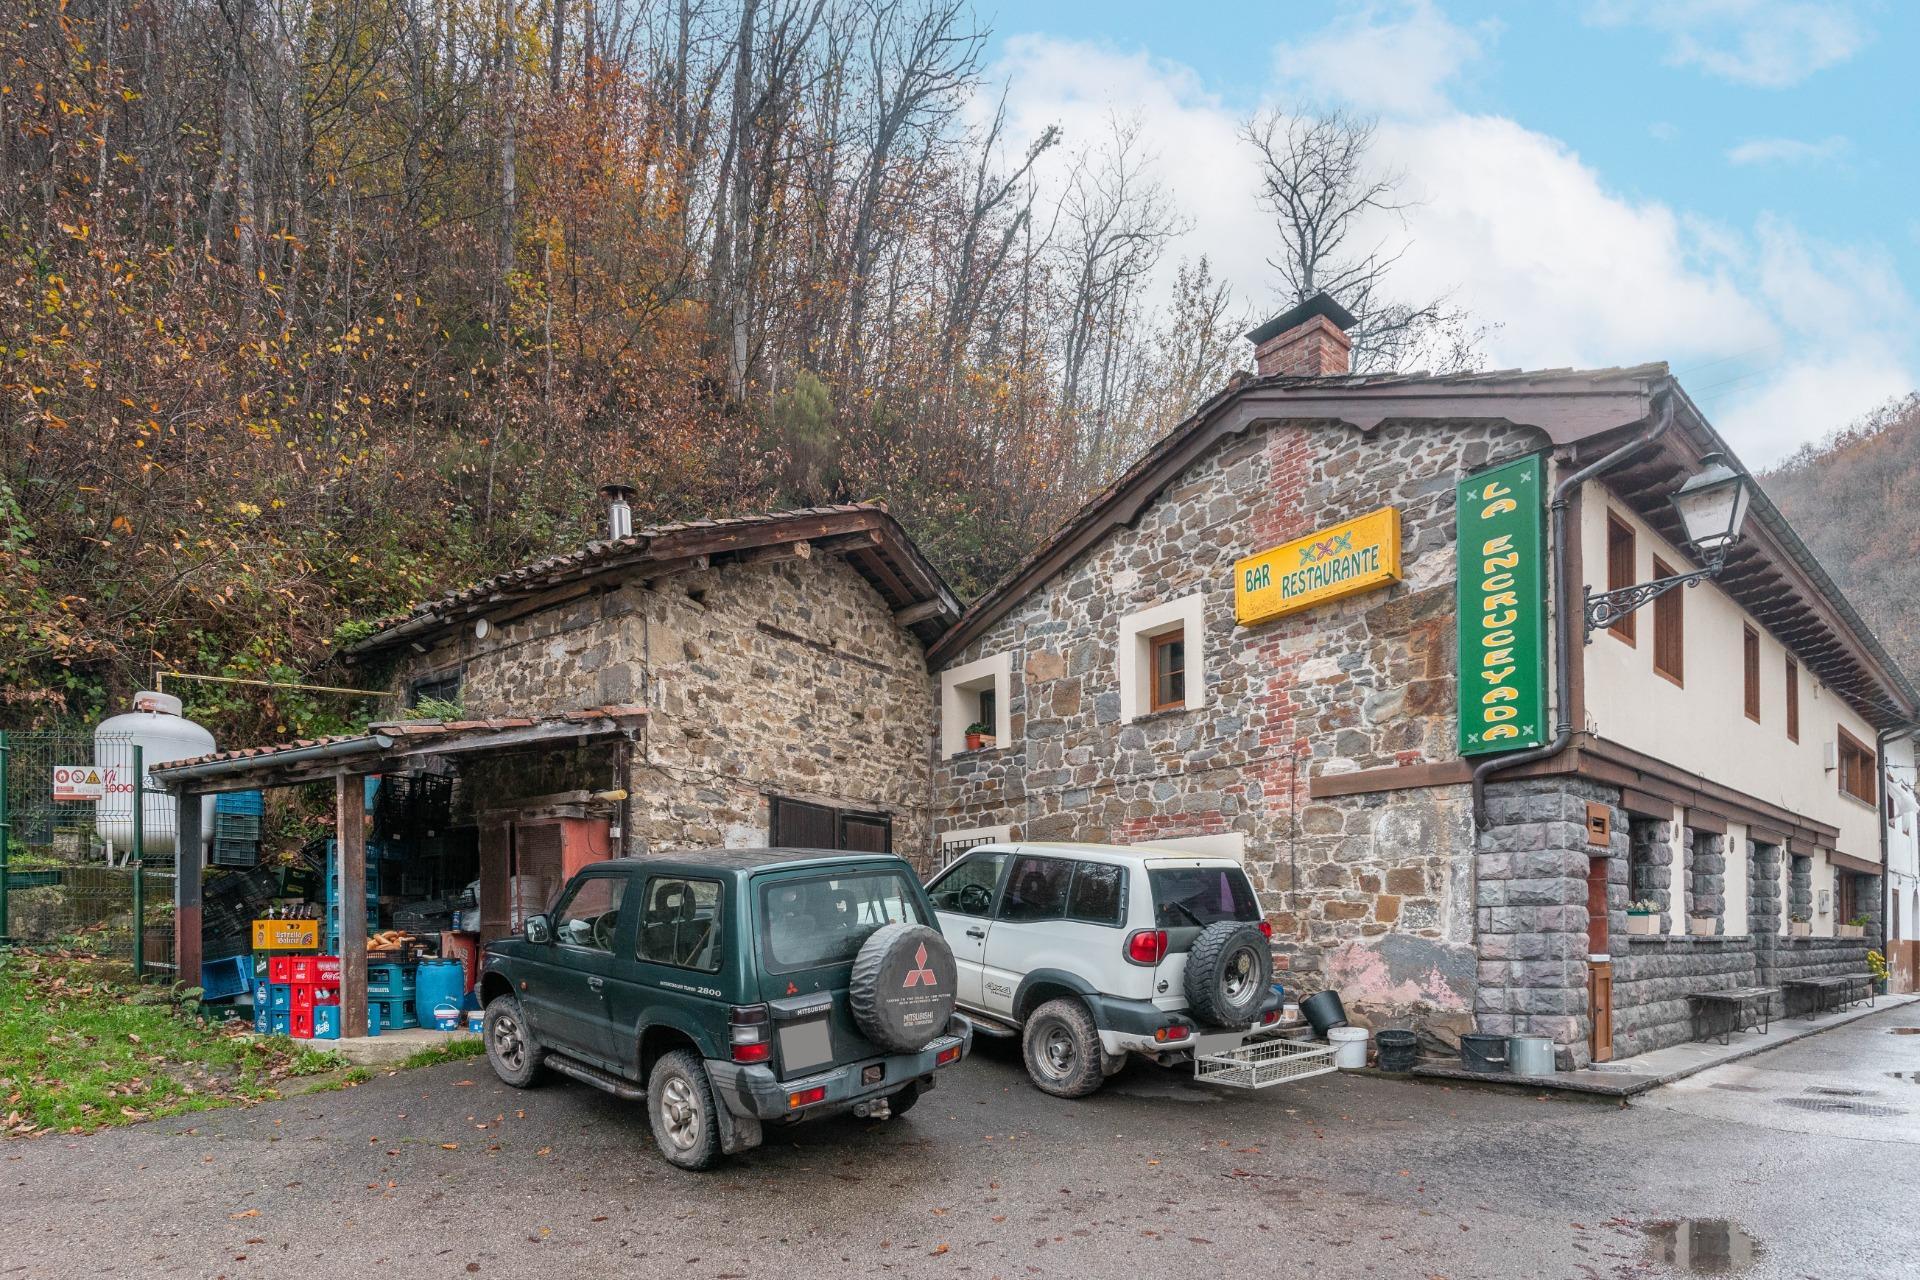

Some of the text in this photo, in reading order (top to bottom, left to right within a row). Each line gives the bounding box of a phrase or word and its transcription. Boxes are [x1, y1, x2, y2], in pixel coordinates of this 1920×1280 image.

[1245, 546, 1380, 599] BAR RESTAURANTE
[1481, 482, 1520, 742] LA ENCRUCEYADA
[697, 986, 722, 997] 2800
[797, 1003, 832, 1016] MITSUBISHI
[903, 1010, 934, 1023] MITSUBISHI
